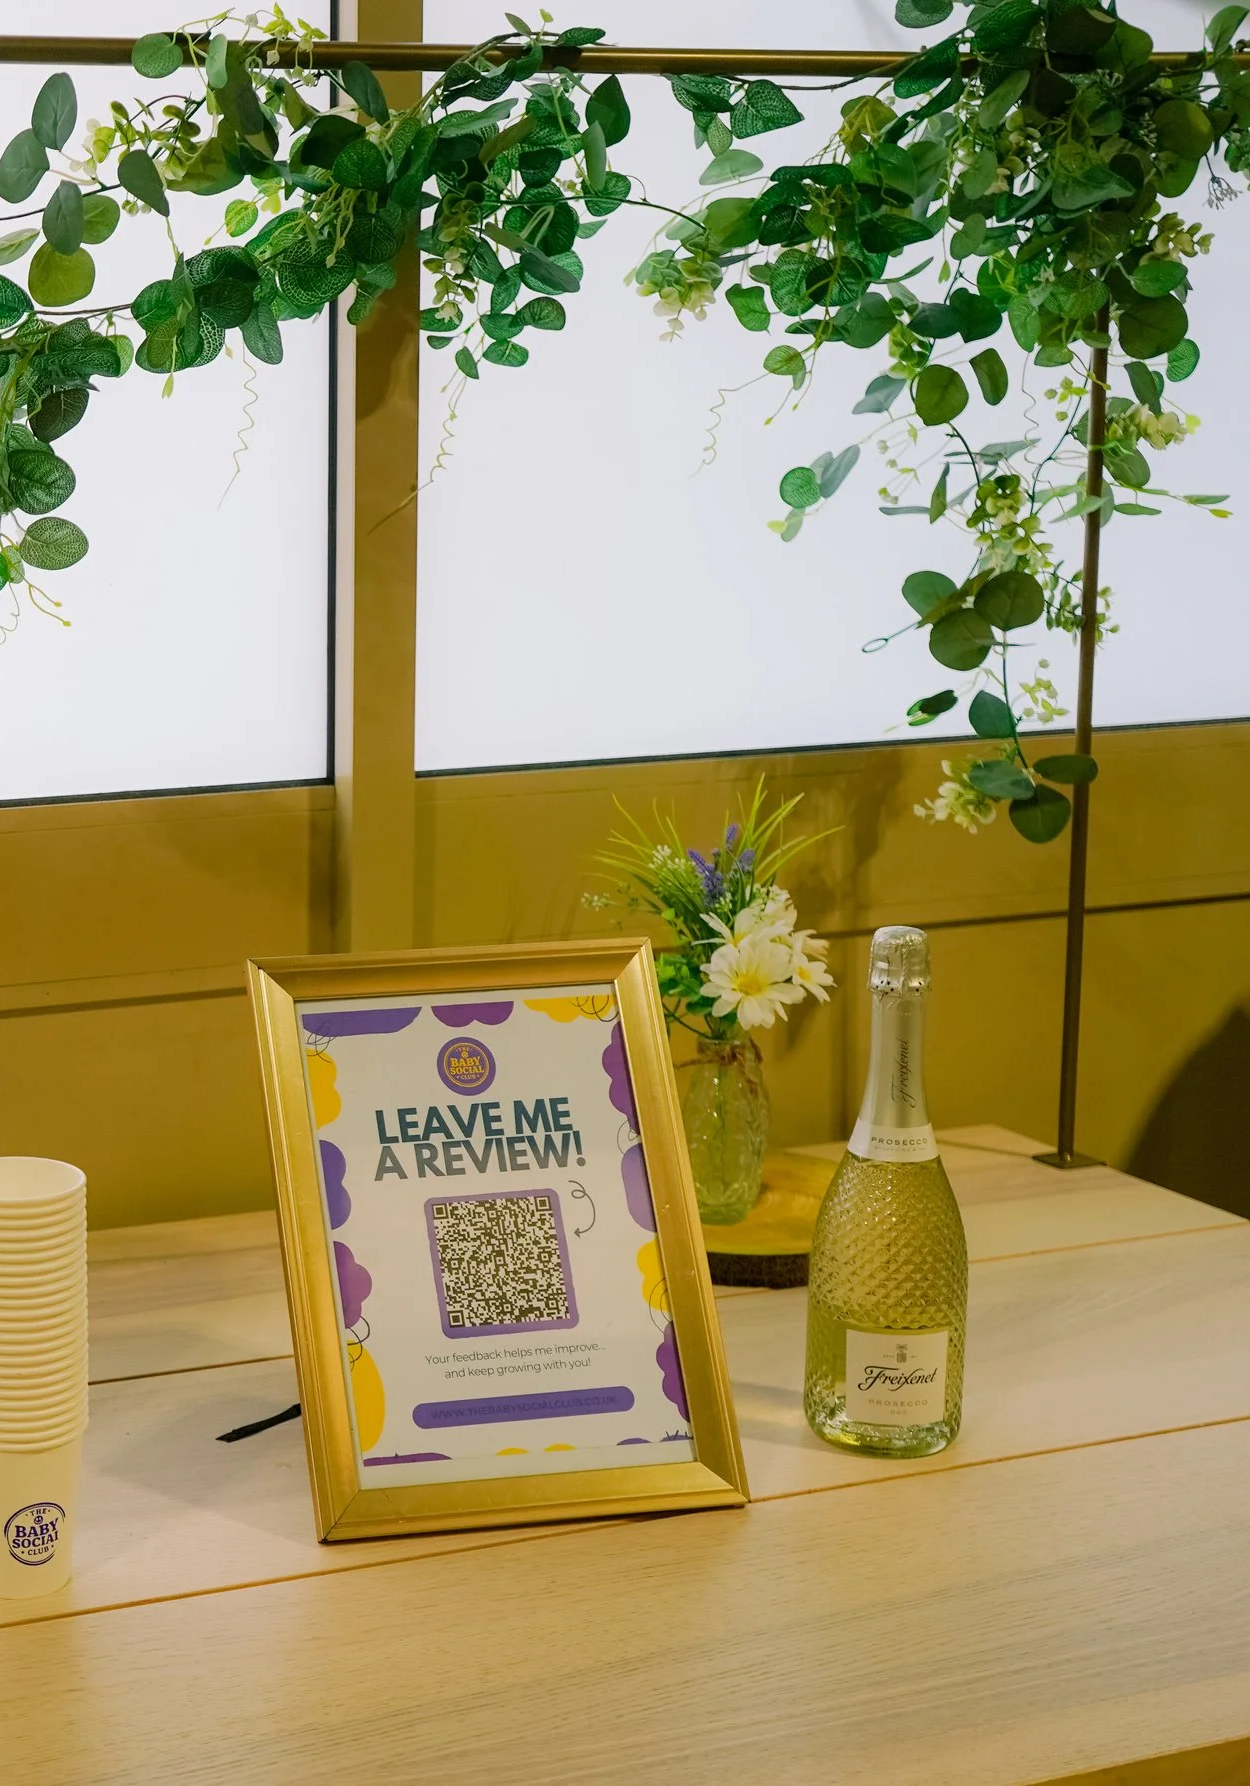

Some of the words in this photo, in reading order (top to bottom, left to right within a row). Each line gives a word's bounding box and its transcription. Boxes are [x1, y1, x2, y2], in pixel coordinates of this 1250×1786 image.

[450, 1056, 480, 1067] BABY
[450, 1066, 484, 1075] SOCIAL
[375, 1101, 505, 1145] LEAVE
[513, 1096, 574, 1135] ME
[870, 1136, 928, 1146] PROSECCO
[374, 1145, 409, 1182] A
[413, 1130, 587, 1179] REVIEW!
[424, 1354, 451, 1366] Your
[452, 1349, 503, 1364] feedback
[503, 1347, 533, 1360] helps
[534, 1346, 553, 1356] me
[554, 1341, 606, 1355] improve...
[445, 1367, 466, 1379] and
[468, 1364, 495, 1378] keep
[496, 1361, 542, 1376] growing
[543, 1357, 568, 1371] with
[568, 1357, 592, 1371] you!
[857, 1365, 939, 1392] Freixenet
[868, 1398, 929, 1408] PROSECCO
[29, 1508, 48, 1517] THE
[15, 1517, 59, 1538] BABY
[27, 1546, 49, 1556] CLUB
